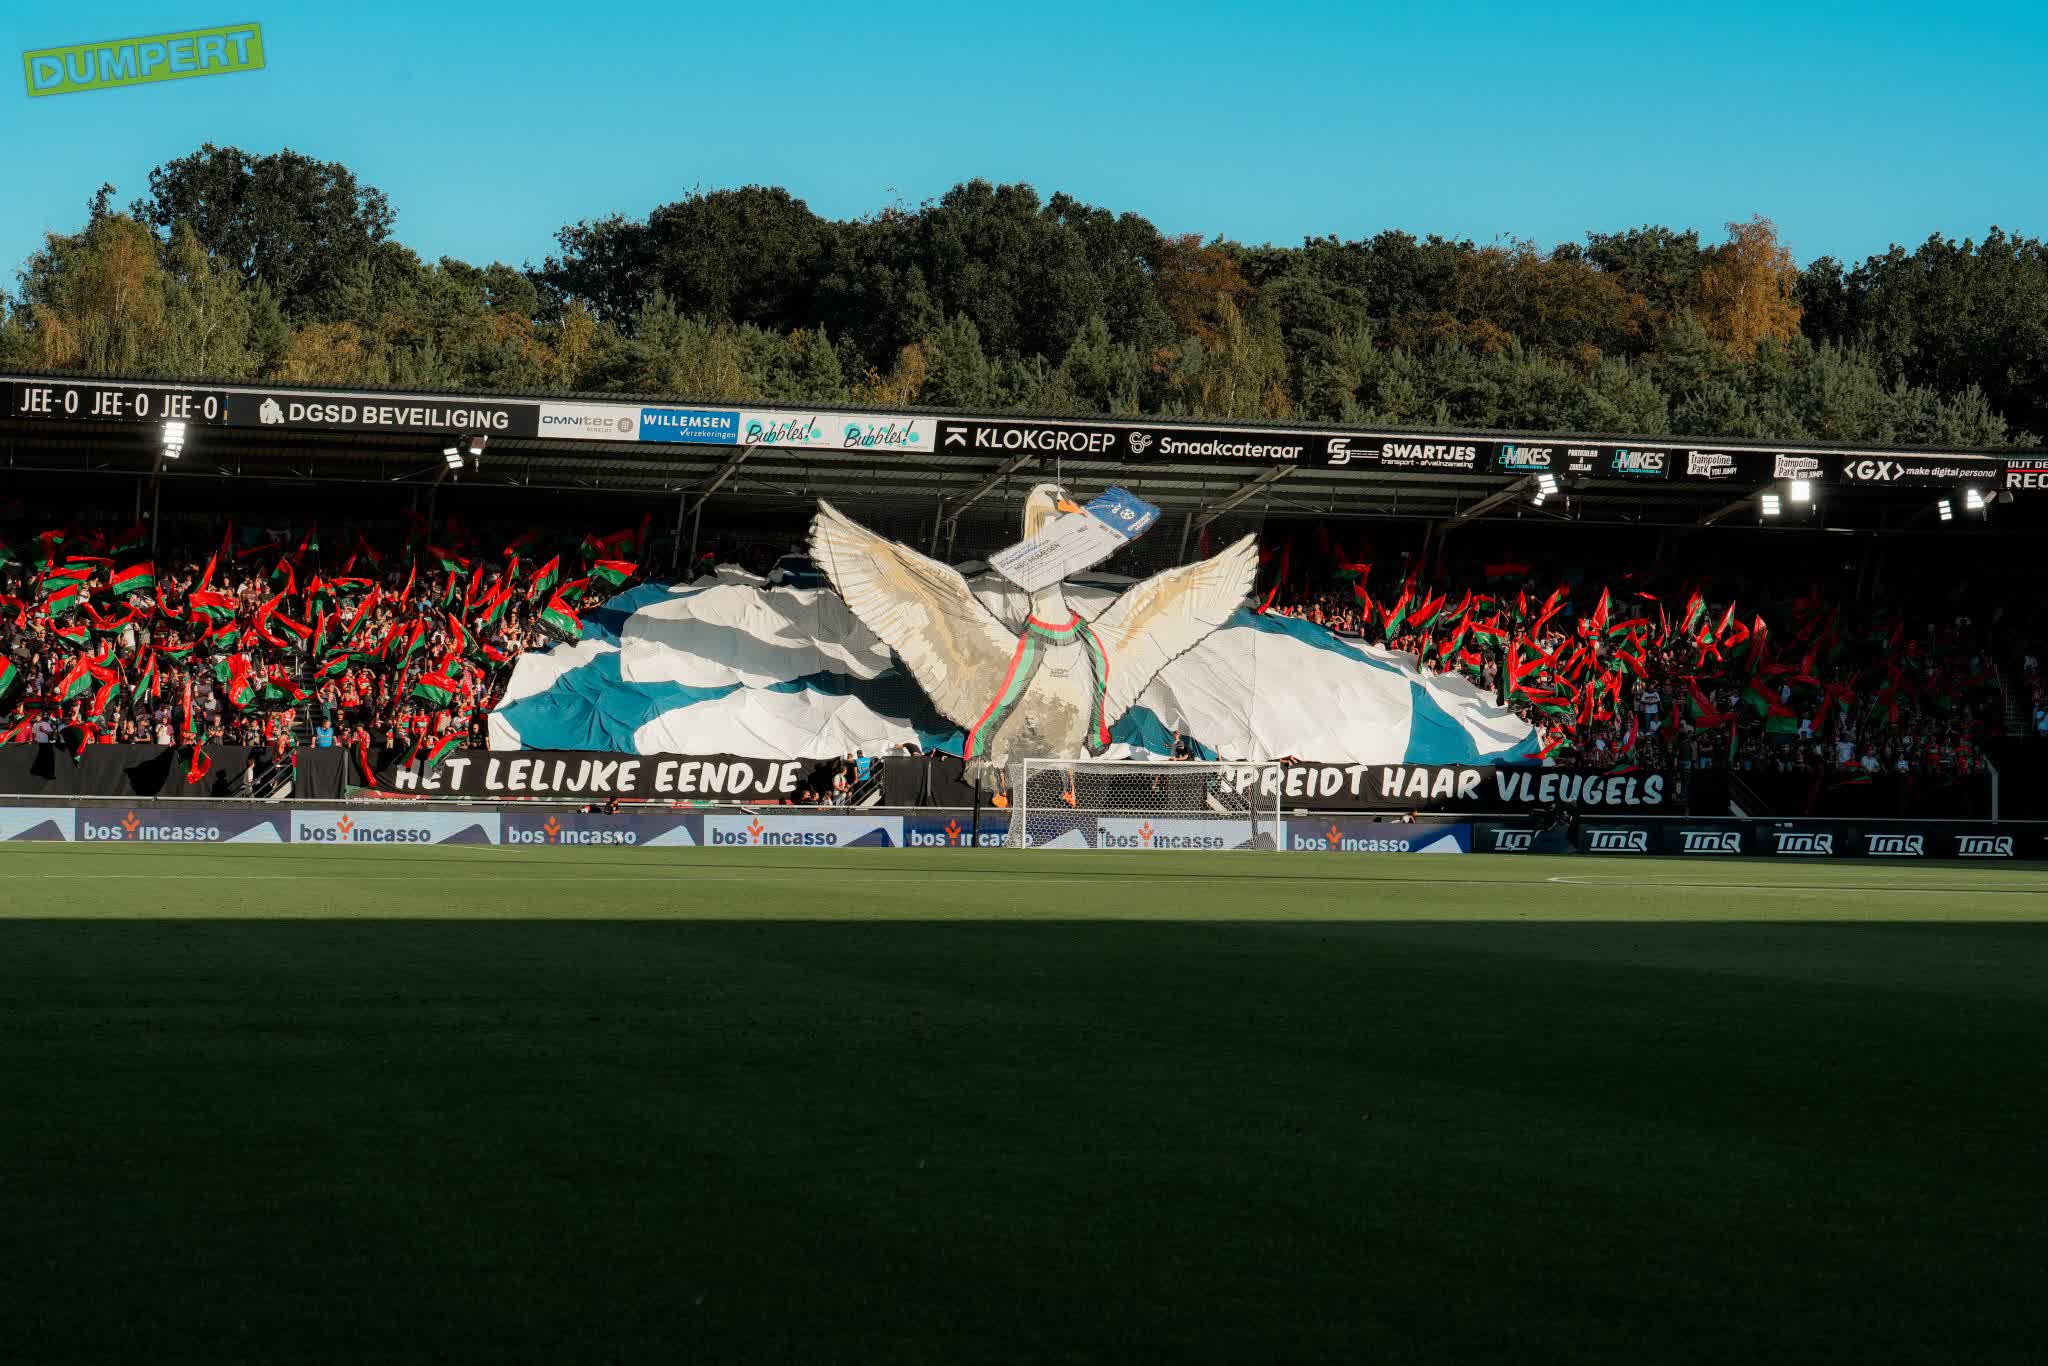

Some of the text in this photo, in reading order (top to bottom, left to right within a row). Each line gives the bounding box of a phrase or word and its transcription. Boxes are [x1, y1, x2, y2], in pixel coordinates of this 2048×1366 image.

[289, 403, 509, 429] DGSD BEVEILIGING
[643, 414, 731, 429] WILLEMSEN
[745, 416, 816, 444] Bubbles!
[844, 421, 914, 448] Bubbles!
[975, 428, 1116, 453] KLOKGROEP
[1159, 437, 1303, 459] Smaakcateraar
[1382, 443, 1476, 461] SWARTJES
[1505, 447, 1552, 466] MIKES
[1618, 451, 1665, 469] MIKES
[1691, 454, 1731, 466] Trampoline
[1381, 458, 1414, 466] transport
[1691, 464, 1708, 473] Park
[1777, 457, 1817, 470] Trampoline
[1778, 467, 1796, 477] Park
[1906, 467, 1997, 478] make digital personal
[485, 758, 640, 792] LELIJKE
[654, 760, 802, 794] EENDJE
[1381, 766, 1482, 800] HAAR
[1495, 770, 1664, 805] VLEUGELS
[84, 821, 219, 841] bos incasso
[300, 823, 431, 843] bos incasso
[508, 826, 637, 844] bos incasso
[712, 828, 837, 845] bos incasso
[911, 829, 945, 847] bos
[1105, 831, 1224, 849] bos incasso
[1294, 832, 1410, 852] bos incasso
